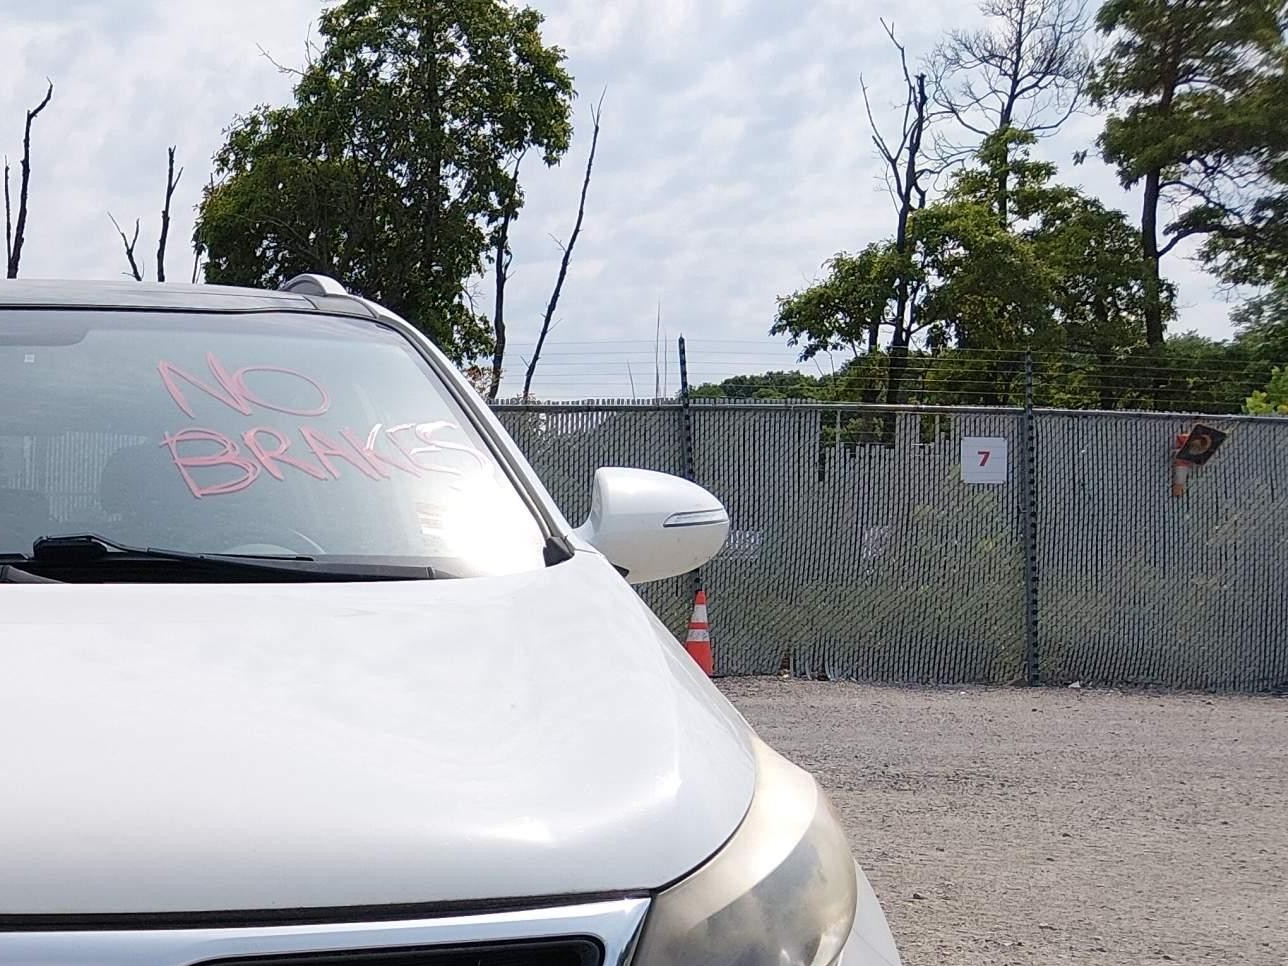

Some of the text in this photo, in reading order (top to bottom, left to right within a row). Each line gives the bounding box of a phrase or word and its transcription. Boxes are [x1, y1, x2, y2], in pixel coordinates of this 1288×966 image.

[157, 351, 331, 418] NO
[159, 421, 495, 498] BRAKES
[977, 451, 990, 467] 7
